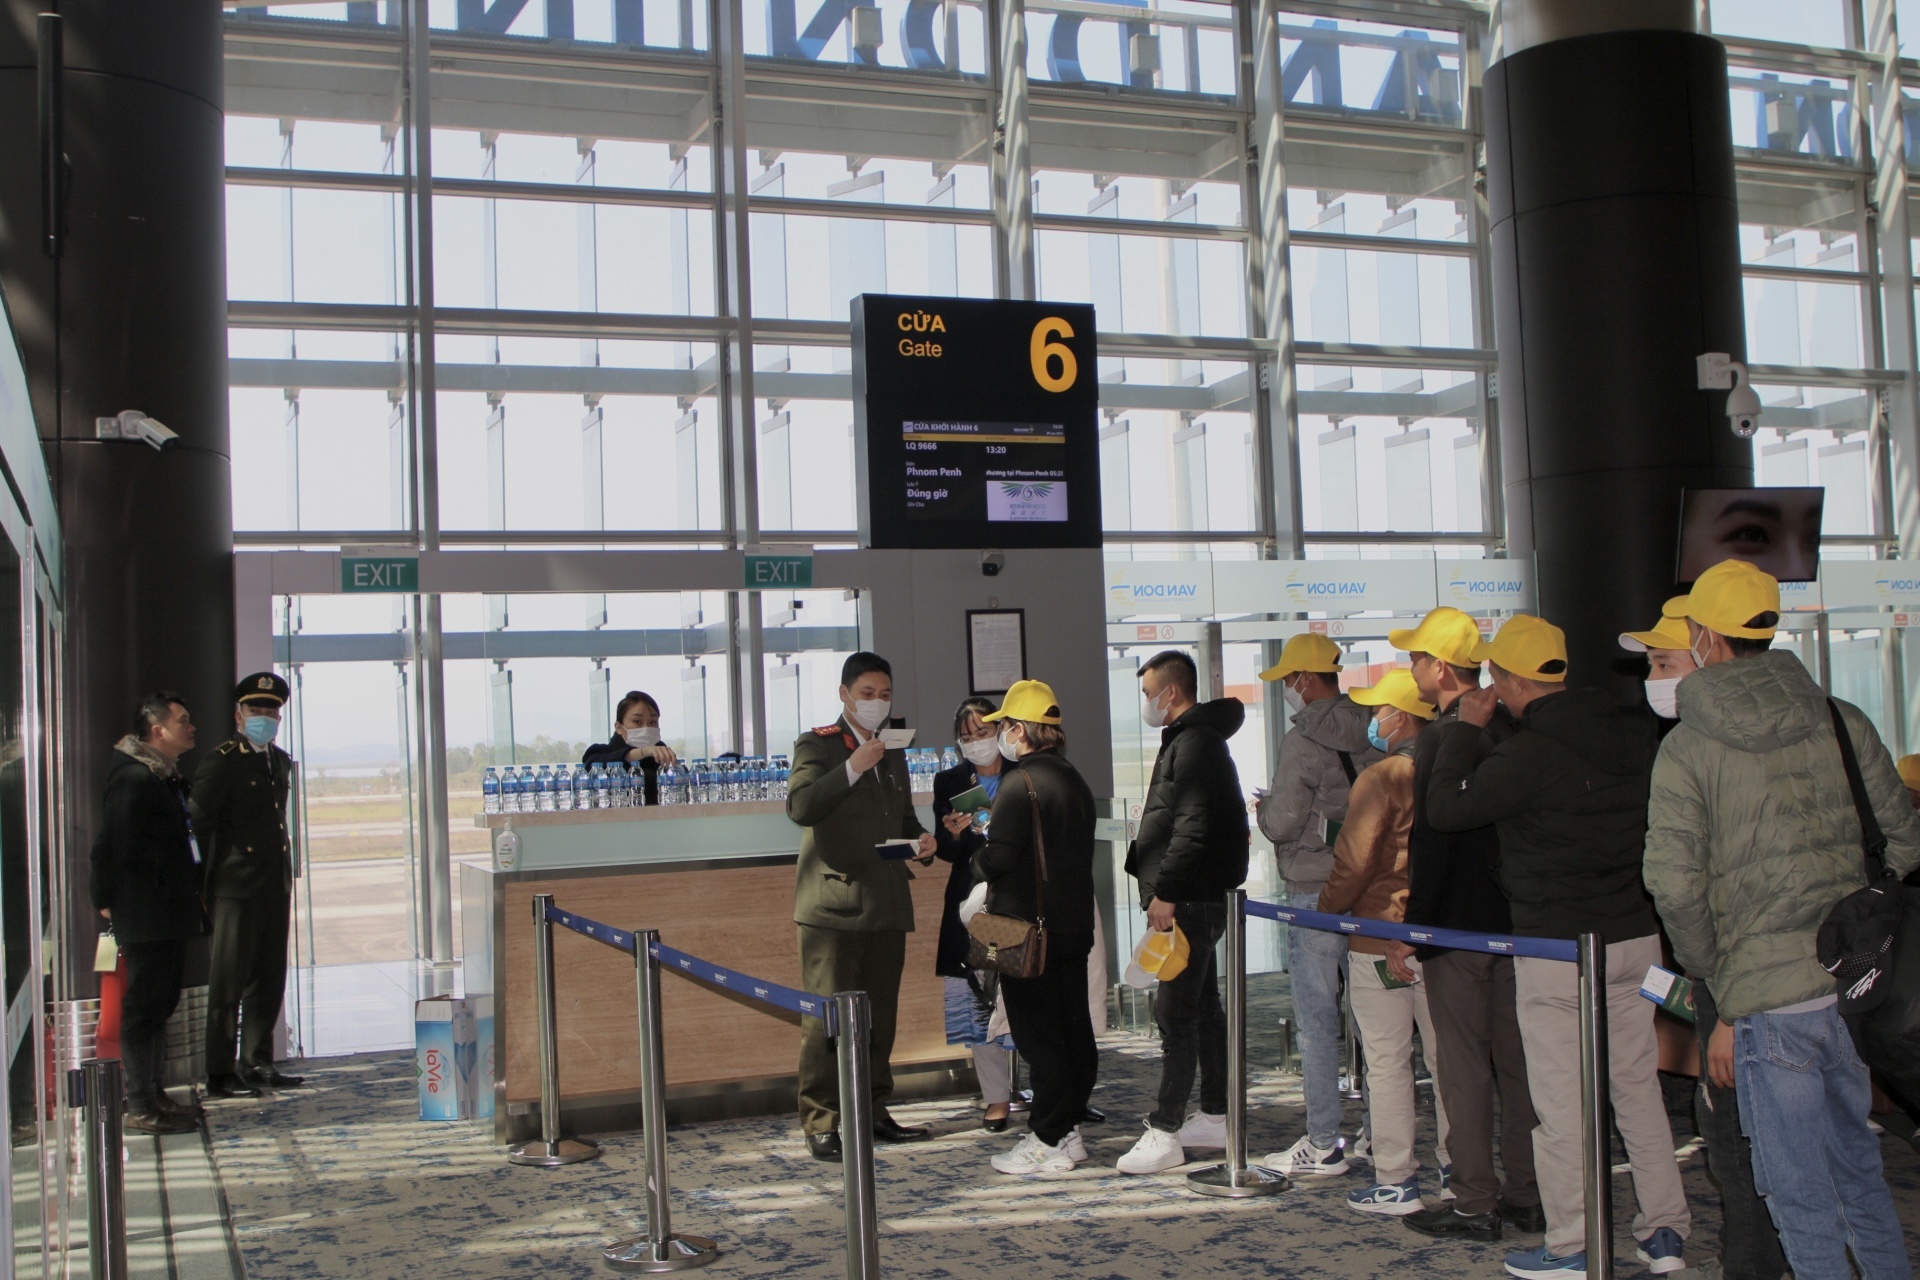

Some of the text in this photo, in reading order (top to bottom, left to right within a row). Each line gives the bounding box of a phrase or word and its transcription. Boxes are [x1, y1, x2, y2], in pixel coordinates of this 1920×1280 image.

[897, 309, 947, 333] CỬA
[898, 338, 943, 358] Gate
[1030, 316, 1078, 393] 6
[913, 421, 930, 431] CỬA
[950, 422, 973, 432] HÀNH
[973, 424, 979, 432] 6
[905, 441, 938, 451] LQ 9666
[985, 445, 1007, 454] 13:20
[906, 467, 962, 477] Phnom Penh
[907, 488, 949, 500] Đúng giờ
[353, 563, 407, 586] EXIT
[755, 560, 802, 582] EXIT
